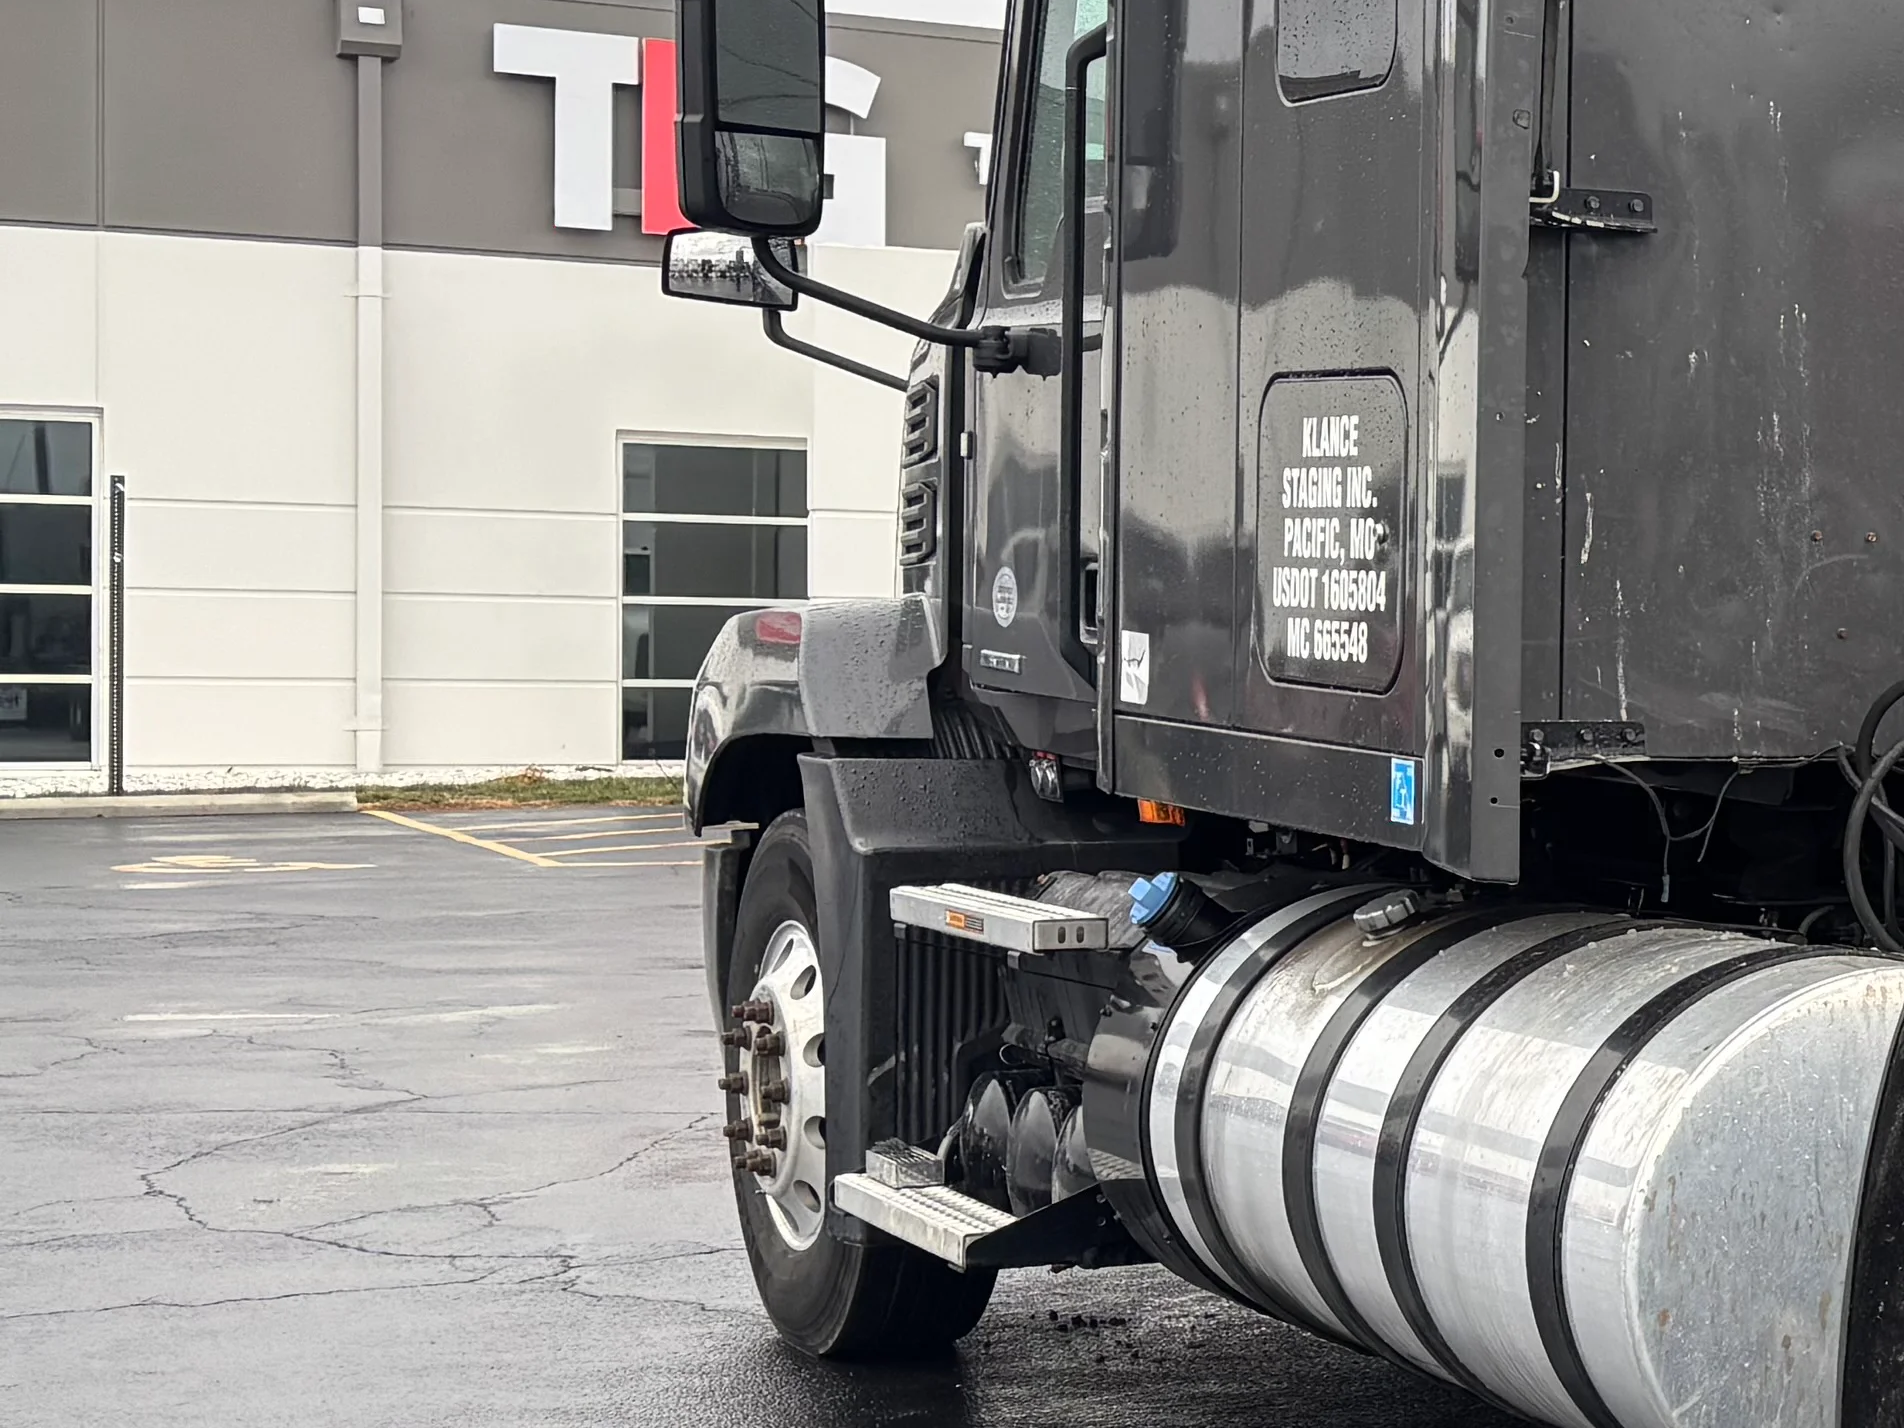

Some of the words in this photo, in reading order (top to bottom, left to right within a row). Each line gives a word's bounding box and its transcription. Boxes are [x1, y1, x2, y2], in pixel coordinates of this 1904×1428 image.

[1302, 415, 1359, 457] KLANCE
[1282, 467, 1342, 508] STAGING
[1347, 466, 1377, 508] INC.
[1284, 517, 1346, 565] PACIFIC,
[1350, 518, 1376, 560] MO
[1272, 568, 1318, 608] USDOT
[1321, 569, 1386, 611] 1605804
[1287, 617, 1310, 659] MC
[1314, 619, 1368, 663] 665548
